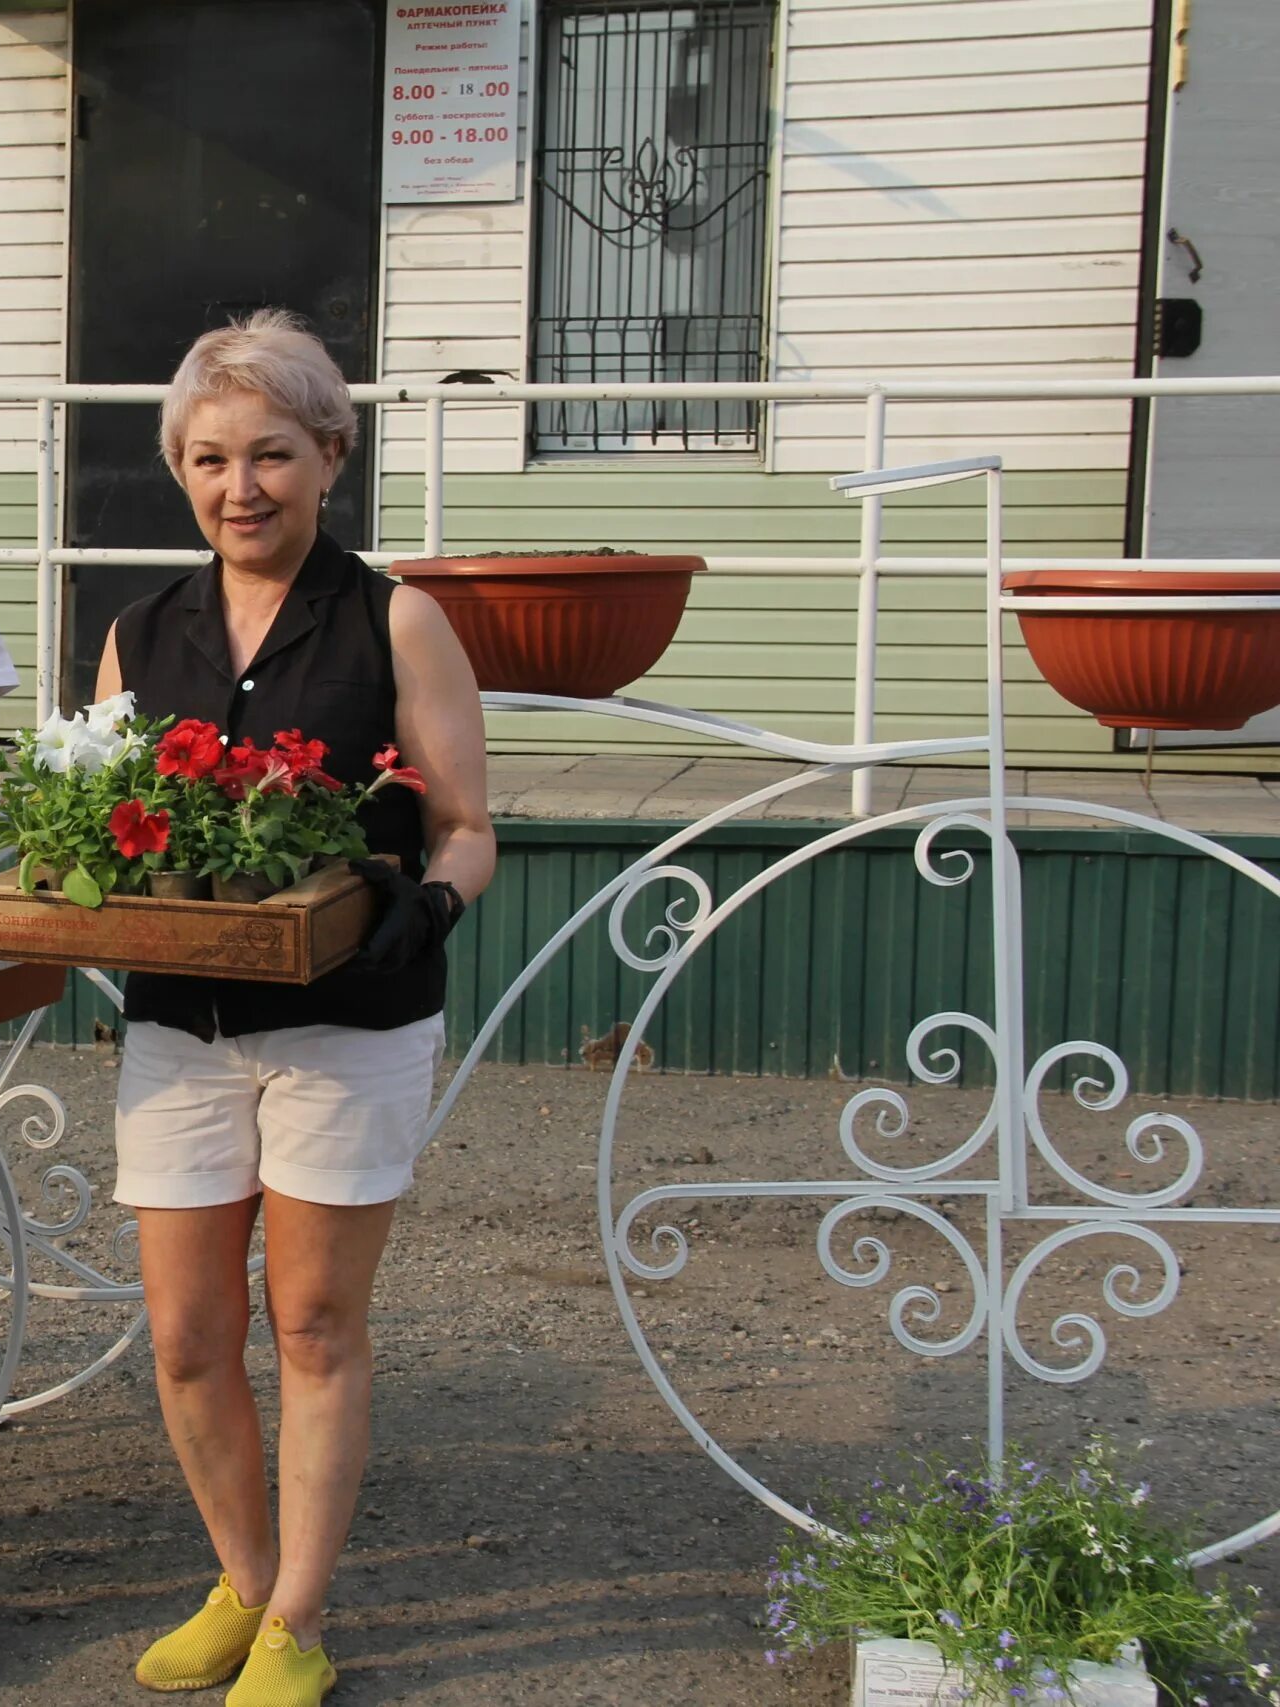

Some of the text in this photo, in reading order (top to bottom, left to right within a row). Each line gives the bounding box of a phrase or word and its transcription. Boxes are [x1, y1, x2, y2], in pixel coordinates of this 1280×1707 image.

[396, 2, 508, 18] ФАРМАКОПЕЙКА
[407, 18, 498, 30] АПТЕЧНЫЙ ПУНКТ
[415, 41, 488, 52] Режим работы:
[394, 66, 460, 75] Понедельник
[468, 64, 509, 72] пятница
[392, 84, 435, 101] 8.00
[394, 113, 434, 123] Суббота
[442, 111, 506, 121] воскресенье
[391, 130, 434, 145] 9.00
[454, 127, 508, 143] 18.00
[444, 156, 474, 164] обеда
